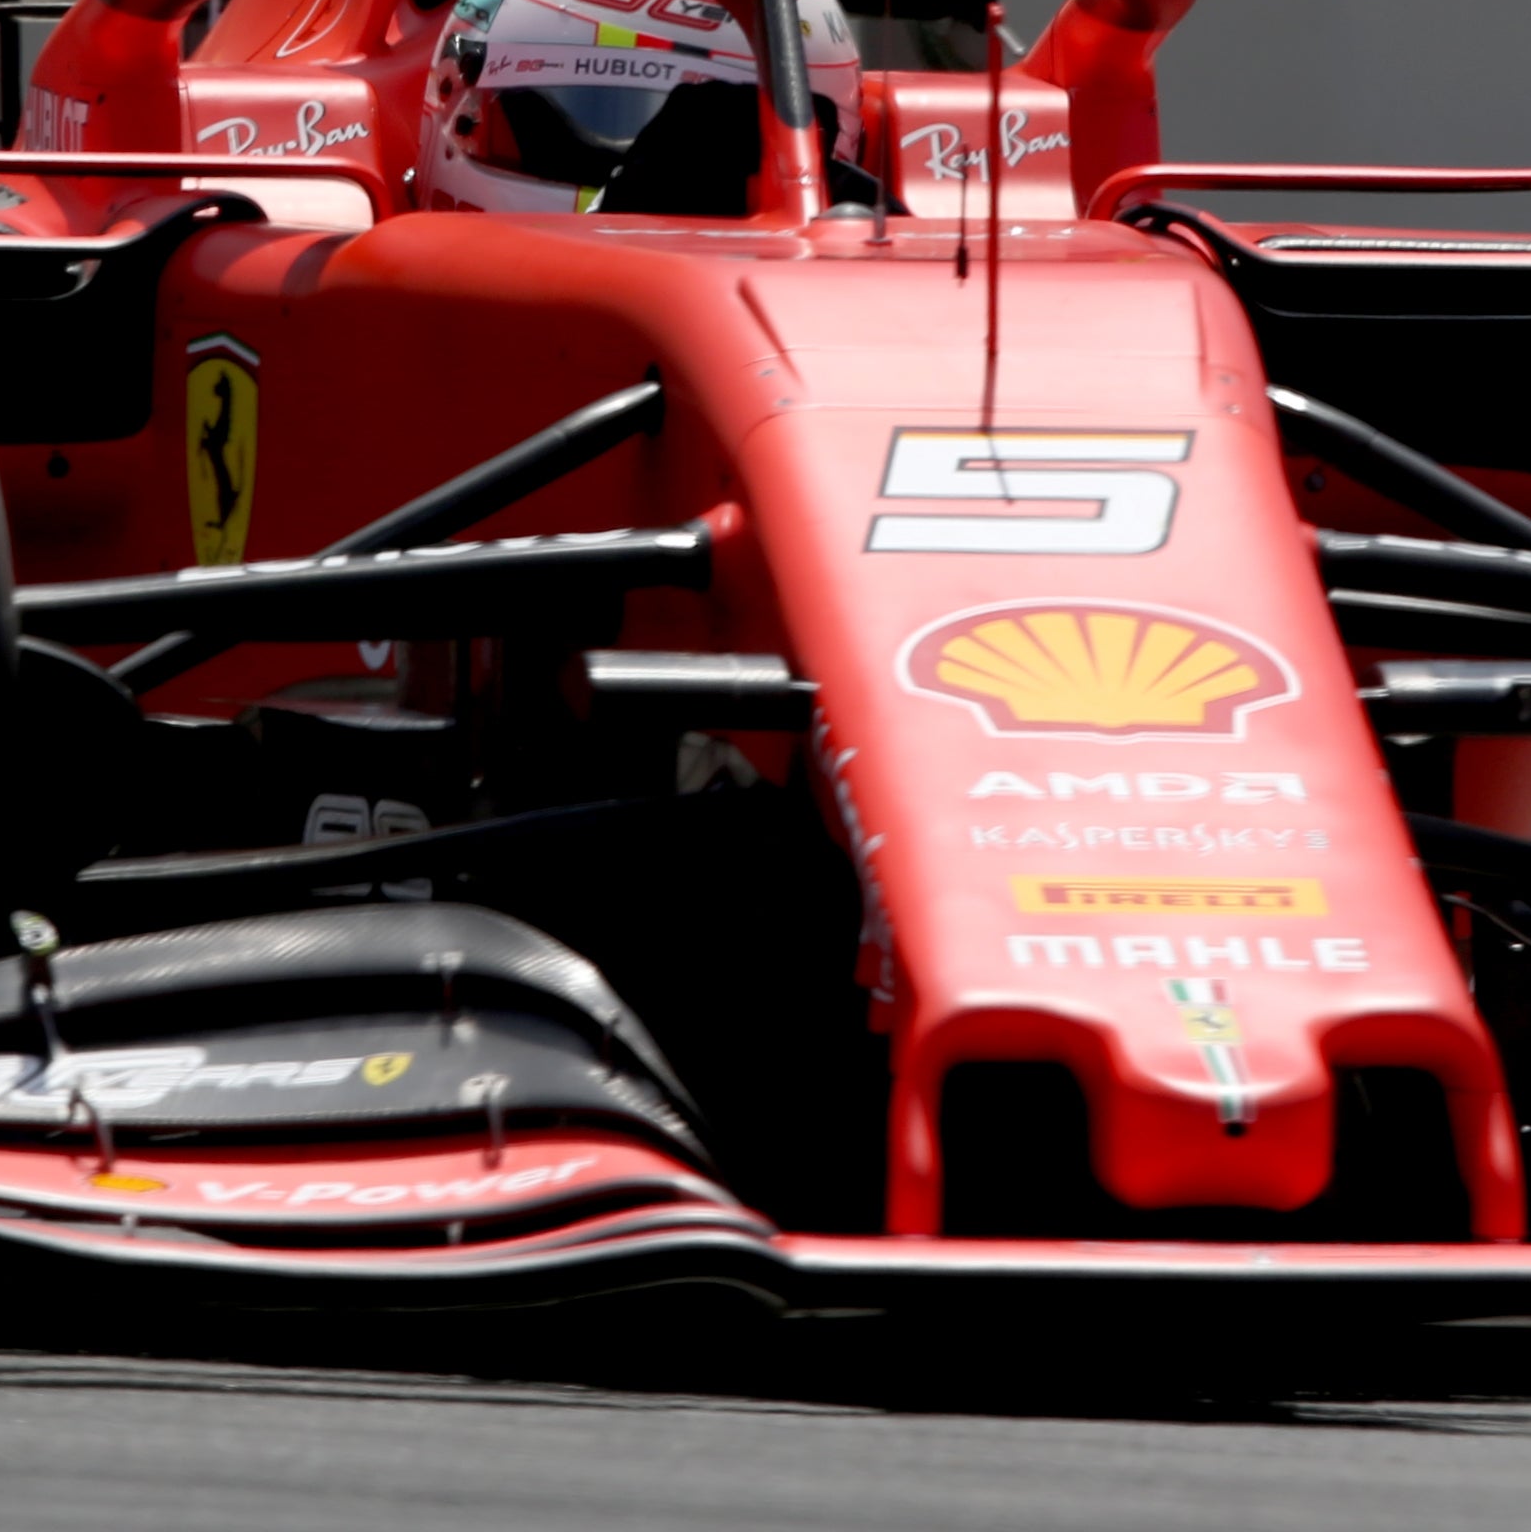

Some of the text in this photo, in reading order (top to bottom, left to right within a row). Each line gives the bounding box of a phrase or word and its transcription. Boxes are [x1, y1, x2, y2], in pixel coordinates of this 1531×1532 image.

[574, 57, 676, 80] HUBLOT
[862, 426, 1197, 555] 5
[968, 771, 1213, 802] AMD
[969, 822, 1296, 856] KASPERSKY
[1040, 883, 1297, 908] PIRELLI
[1006, 934, 1372, 972] MAHLE
[196, 1155, 599, 1205] V-Power
